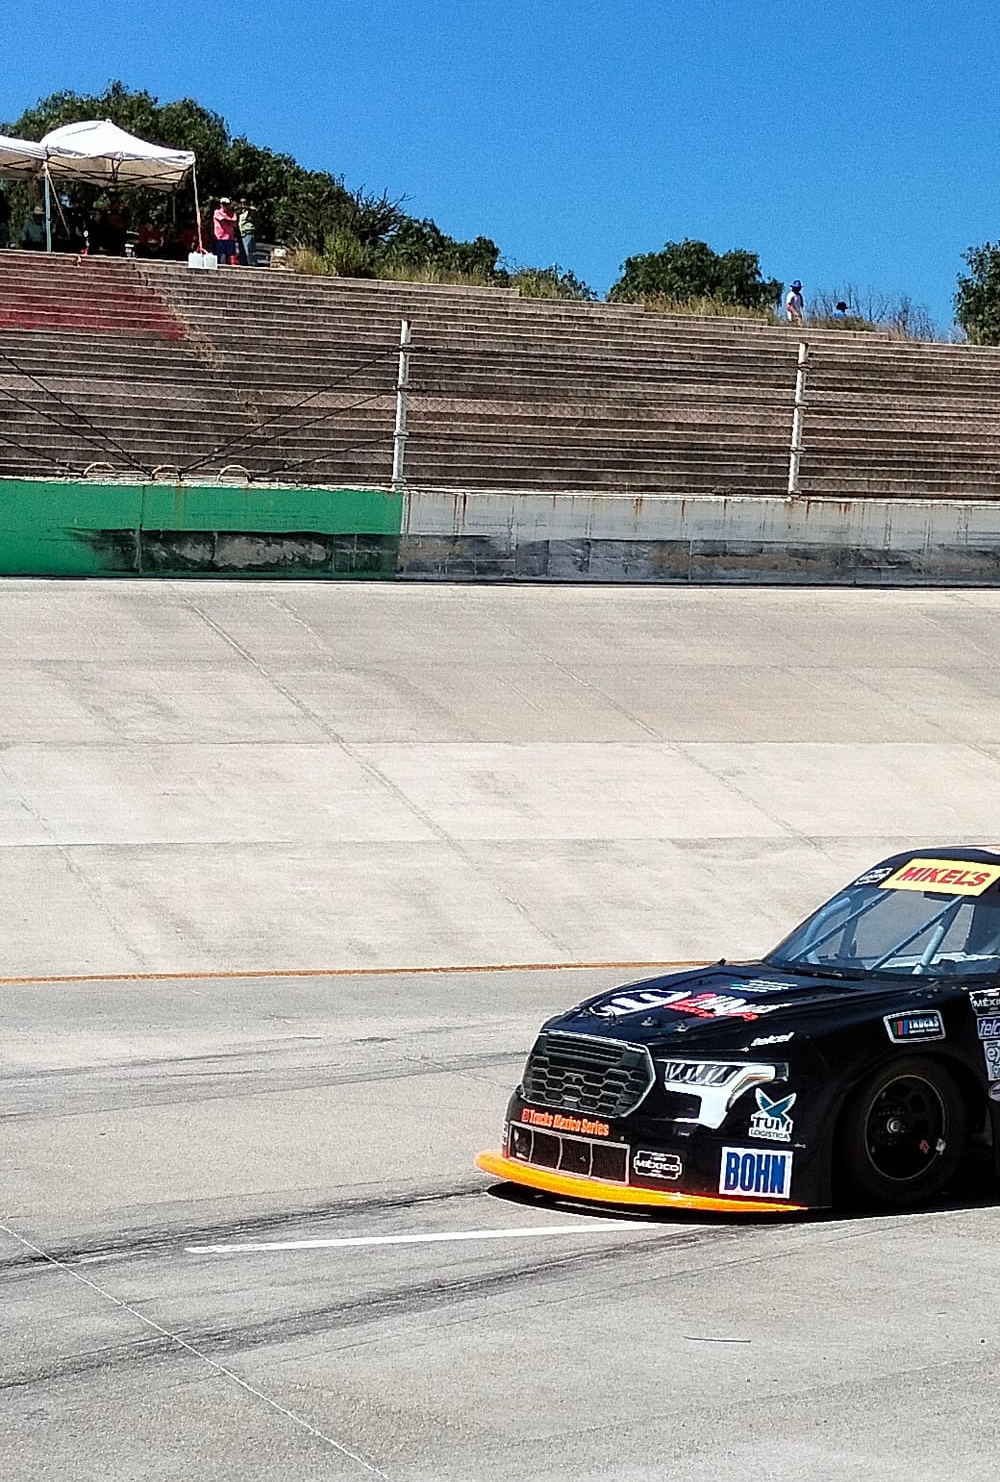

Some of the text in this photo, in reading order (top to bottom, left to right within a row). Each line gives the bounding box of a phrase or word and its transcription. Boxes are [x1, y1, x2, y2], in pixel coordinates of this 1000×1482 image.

[896, 867, 991, 886] MIKEL'S
[529, 1109, 609, 1136] Trucks Mexico Series
[723, 1151, 787, 1194] BOHN
